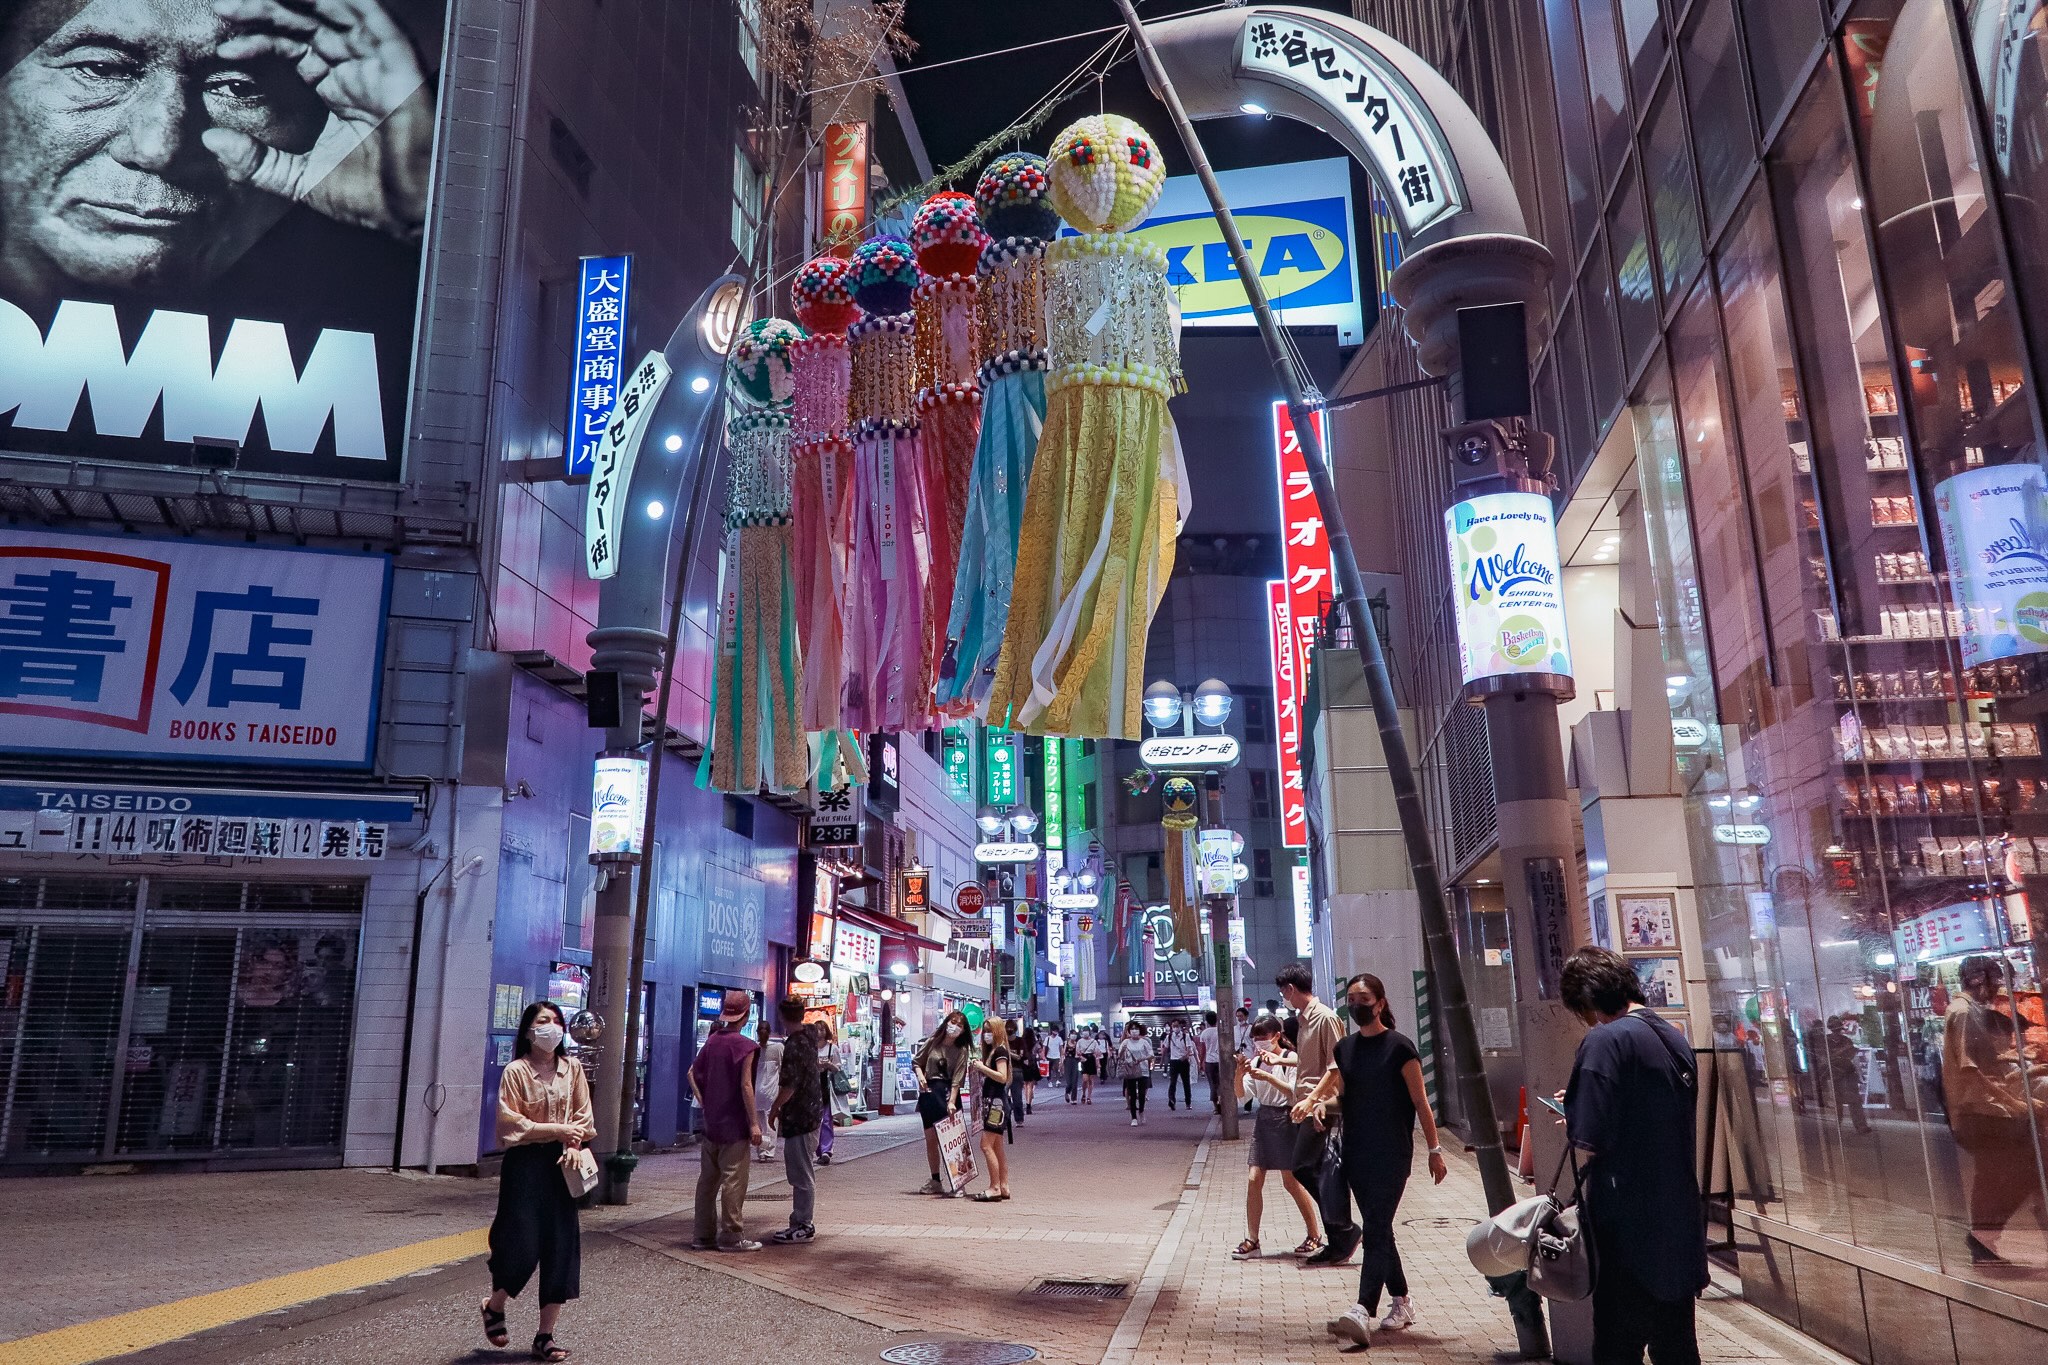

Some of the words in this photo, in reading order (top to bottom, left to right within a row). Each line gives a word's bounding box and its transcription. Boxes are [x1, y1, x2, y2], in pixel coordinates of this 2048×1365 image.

[1251, 22, 1435, 207] 渋谷センター街
[832, 133, 858, 236] クスリの
[1166, 232, 1326, 284] KEA
[577, 270, 620, 465] 大盛堂商事ビル
[590, 362, 658, 571] 渋谷センター街
[1466, 515, 1490, 527] Have
[1500, 511, 1532, 522] Lovely
[1533, 513, 1547, 524] Day
[1470, 543, 1555, 601] Welcome
[1498, 600, 1558, 609] CENTER-GAI
[1507, 590, 1554, 599] SHIBUYA
[0, 569, 320, 711] 書店
[169, 719, 236, 741] BOOKS
[248, 723, 337, 747] TAISEIDO
[991, 737, 1003, 745] 1F
[1145, 742, 1233, 758] 渋谷センター街
[594, 784, 630, 809] Welcome
[992, 771, 1001, 802] フルーツ
[37, 792, 192, 812] TAISEIDO
[959, 894, 983, 907] 消火栓
[707, 899, 739, 939] BOSS
[1540, 871, 1563, 970] 防犯カメラ作動中
[711, 939, 735, 957] COFFEE
